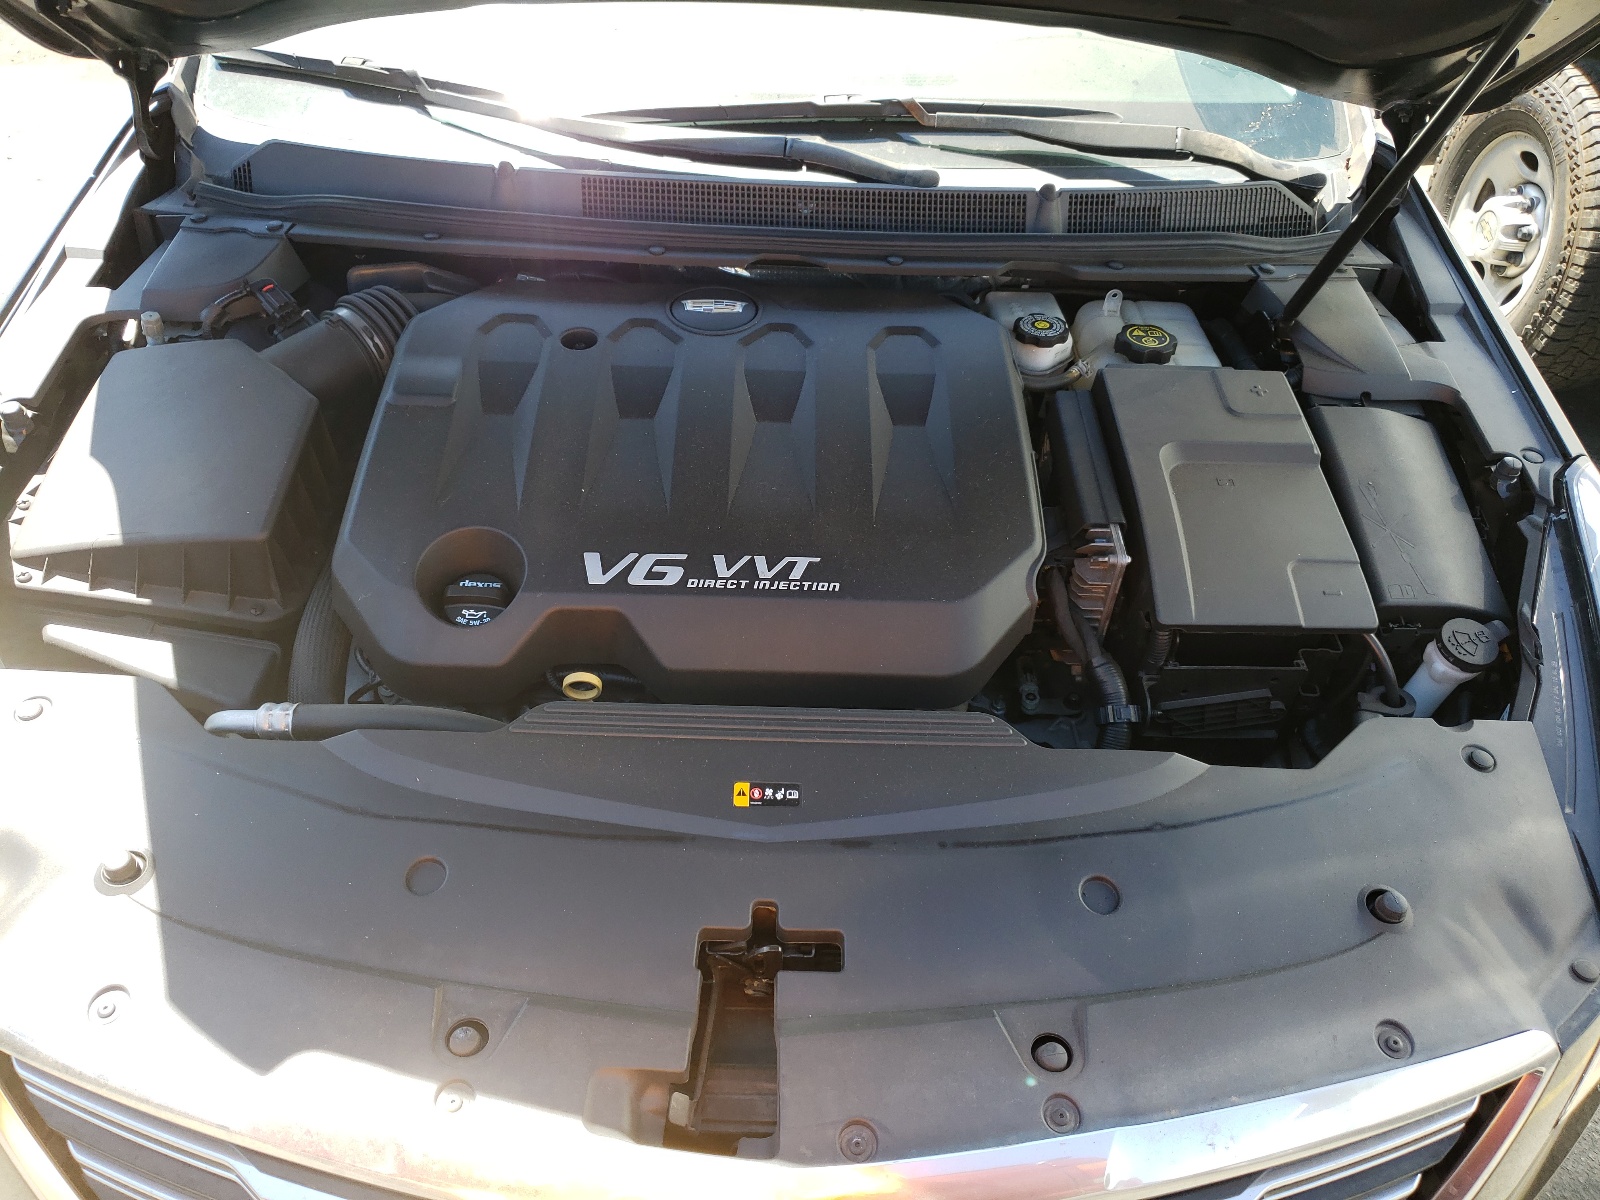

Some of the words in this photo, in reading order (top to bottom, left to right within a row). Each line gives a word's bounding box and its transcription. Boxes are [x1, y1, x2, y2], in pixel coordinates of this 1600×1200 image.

[583, 552, 688, 586] V6
[713, 554, 821, 580] VVT
[687, 578, 749, 589] DIRECT
[753, 580, 840, 592] INJECTION
